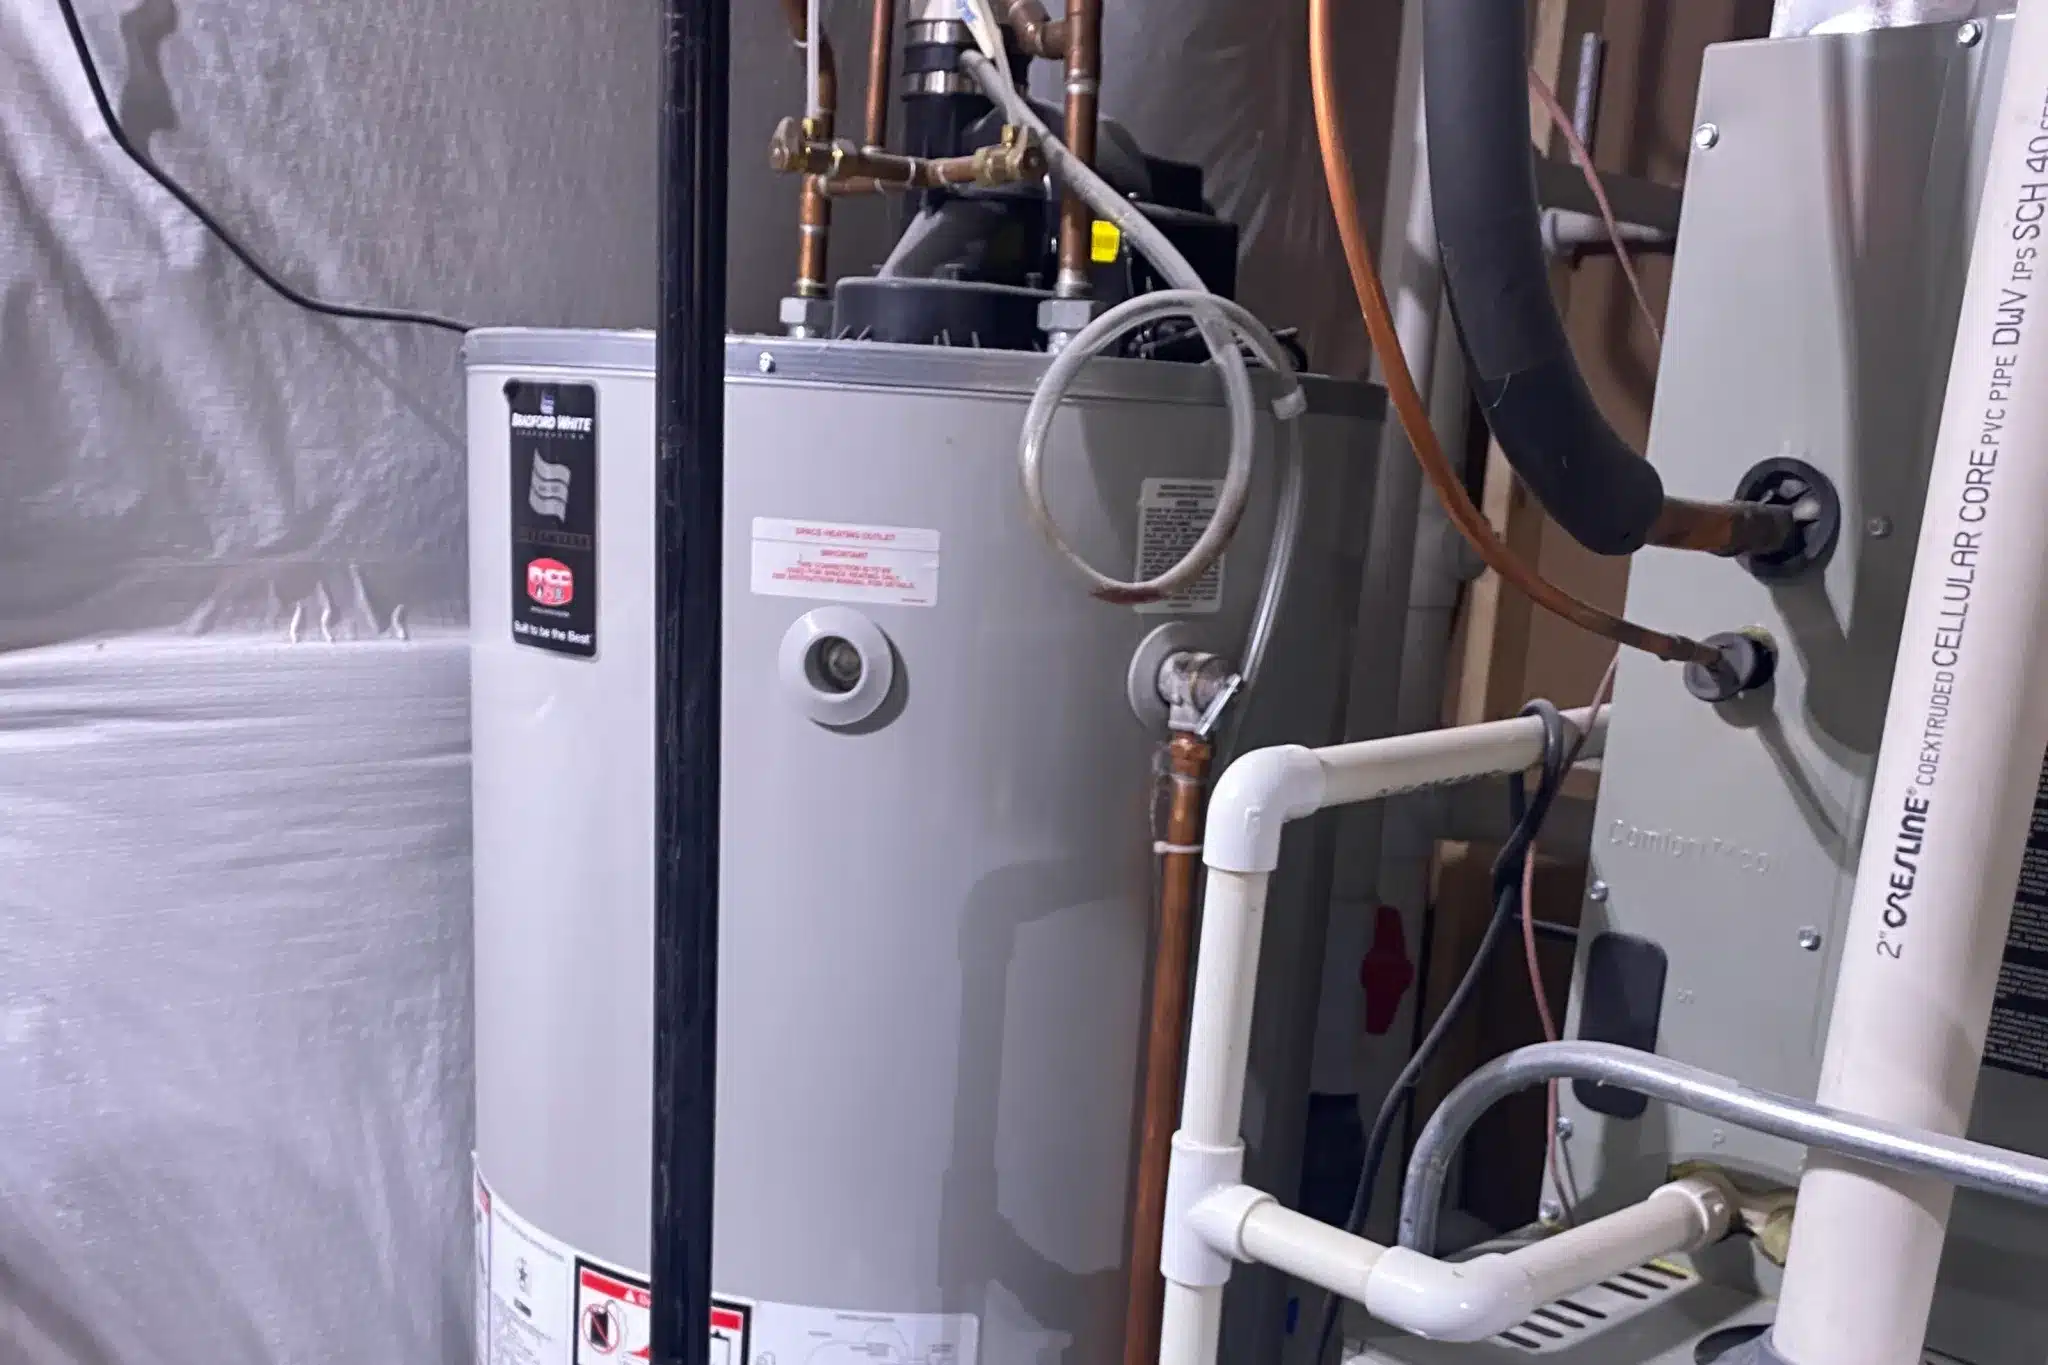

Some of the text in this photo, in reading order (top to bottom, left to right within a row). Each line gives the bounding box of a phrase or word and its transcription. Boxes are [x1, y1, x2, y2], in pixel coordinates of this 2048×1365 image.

[2026, 135, 2048, 174] 40
[2012, 182, 2048, 242] SCH
[2011, 248, 2038, 282] IPS
[1992, 289, 2029, 348] DWV
[1989, 355, 2018, 402] PIPE
[557, 415, 592, 432] WHITE
[1981, 409, 2005, 446] PVC
[1958, 449, 1999, 523] CORE
[1932, 532, 1983, 668] CELLULAR
[1915, 671, 1955, 786] COEXTRUDED
